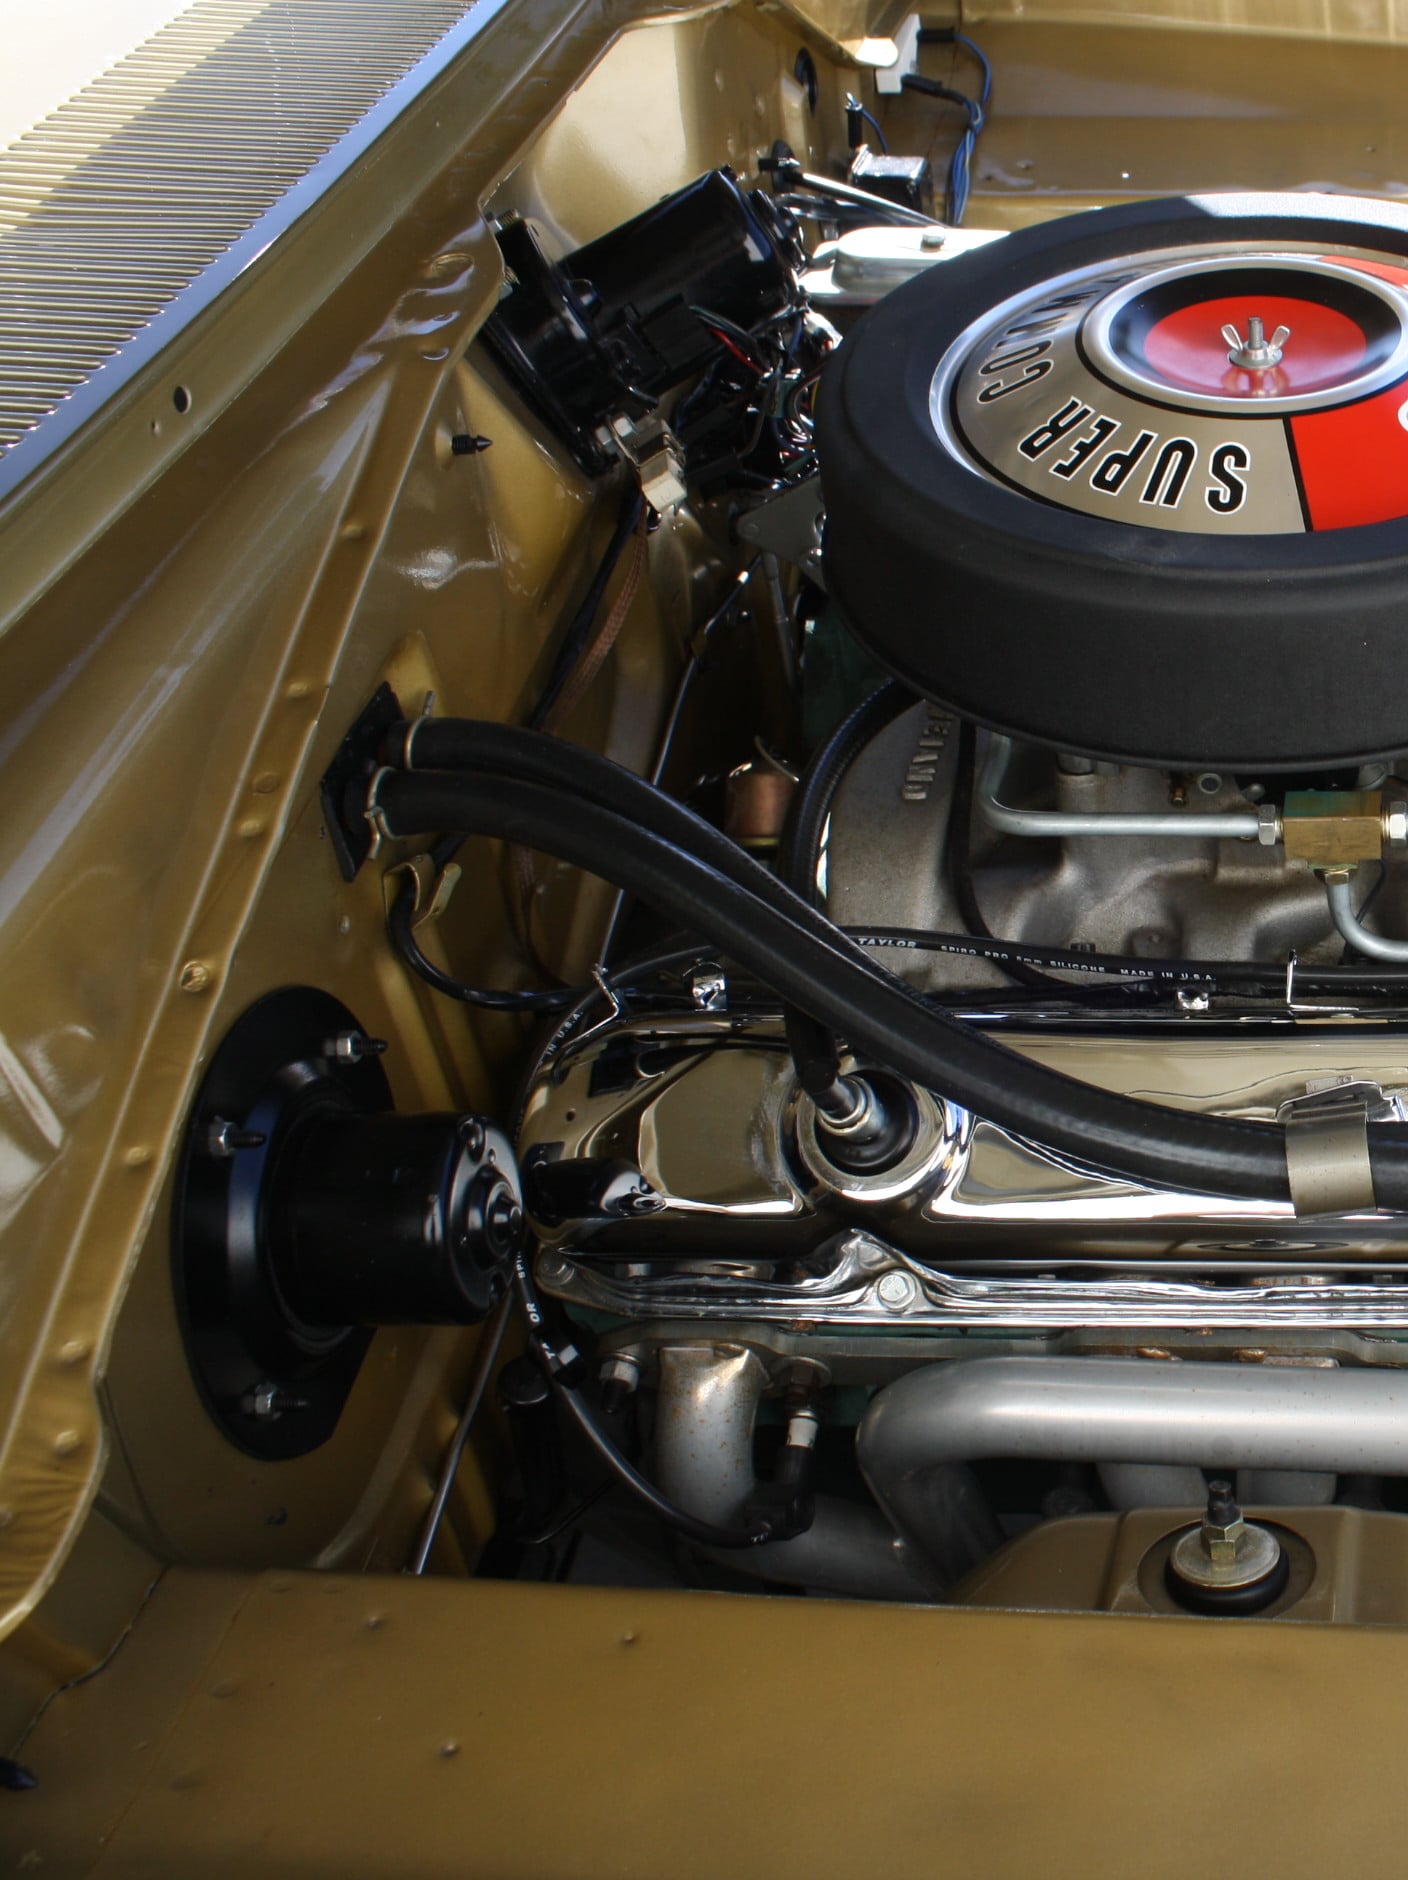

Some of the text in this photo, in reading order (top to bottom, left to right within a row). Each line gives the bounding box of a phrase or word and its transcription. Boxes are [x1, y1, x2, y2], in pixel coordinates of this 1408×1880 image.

[1017, 395, 1250, 515] SUPER
[858, 938, 917, 949] TAYLOR
[1050, 960, 1105, 973] SILICONE
[1120, 968, 1154, 976] MADE
[1161, 971, 1174, 979] IN
